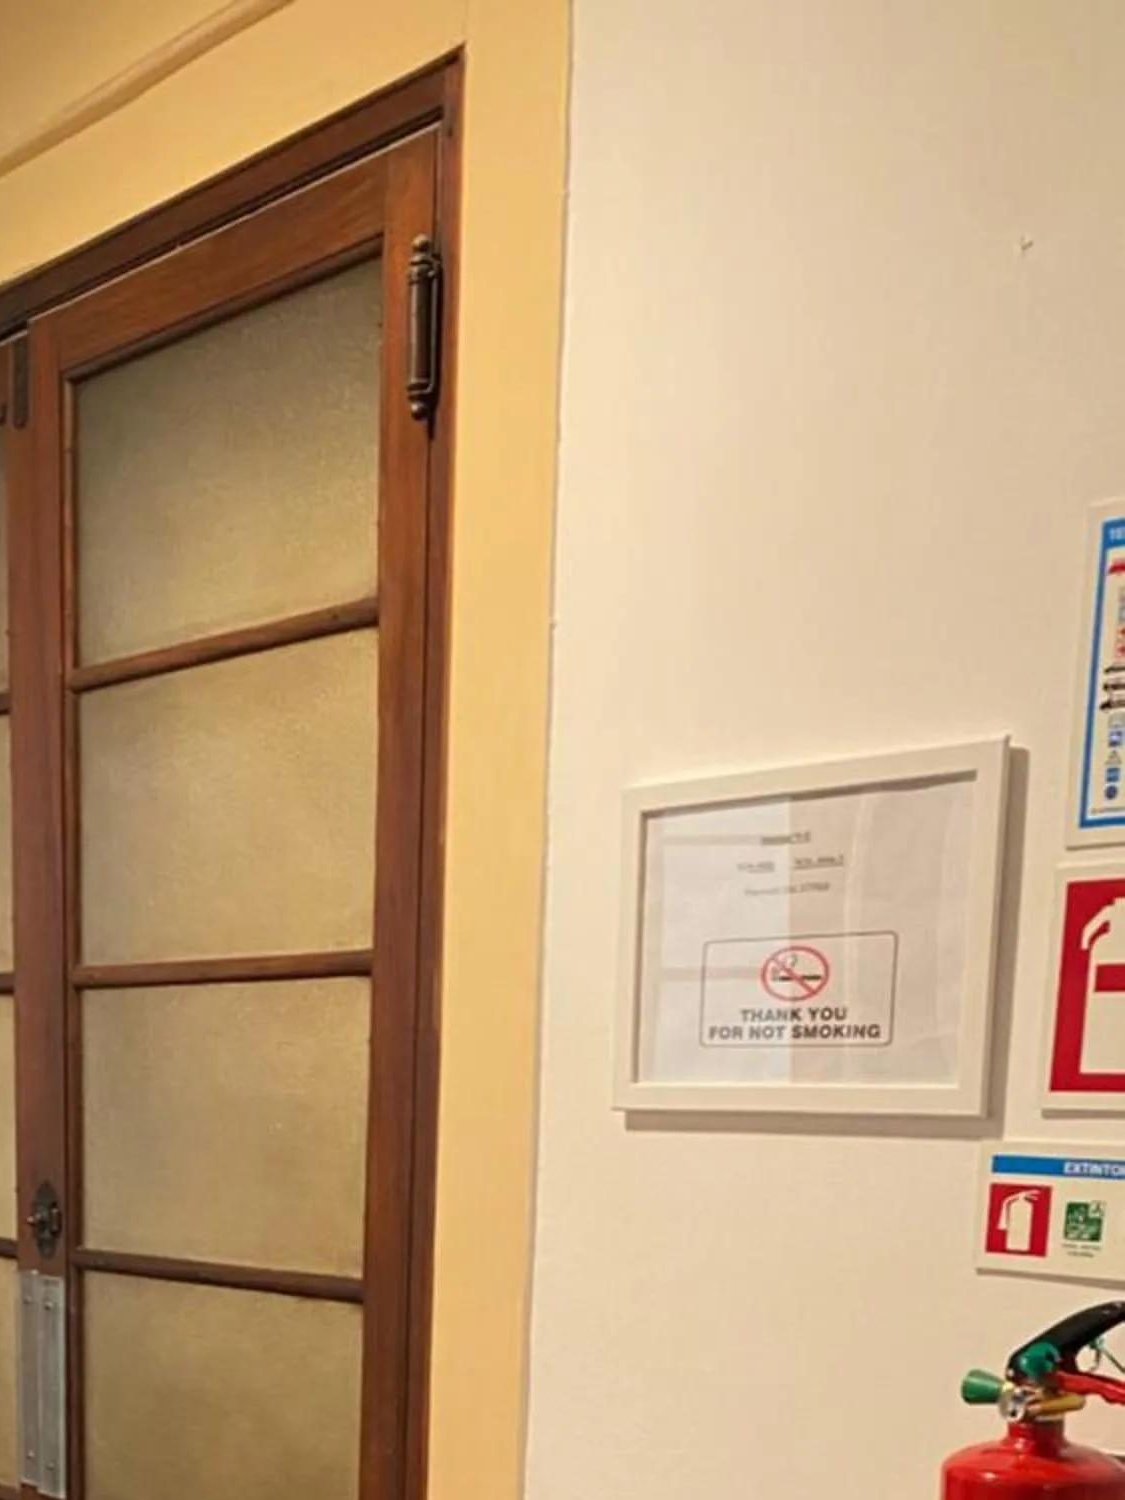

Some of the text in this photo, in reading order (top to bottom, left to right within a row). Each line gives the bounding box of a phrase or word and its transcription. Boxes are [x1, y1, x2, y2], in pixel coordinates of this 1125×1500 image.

[740, 1007, 848, 1022] THANK YOU
[708, 1024, 882, 1040] FOR NOT SMOKING
